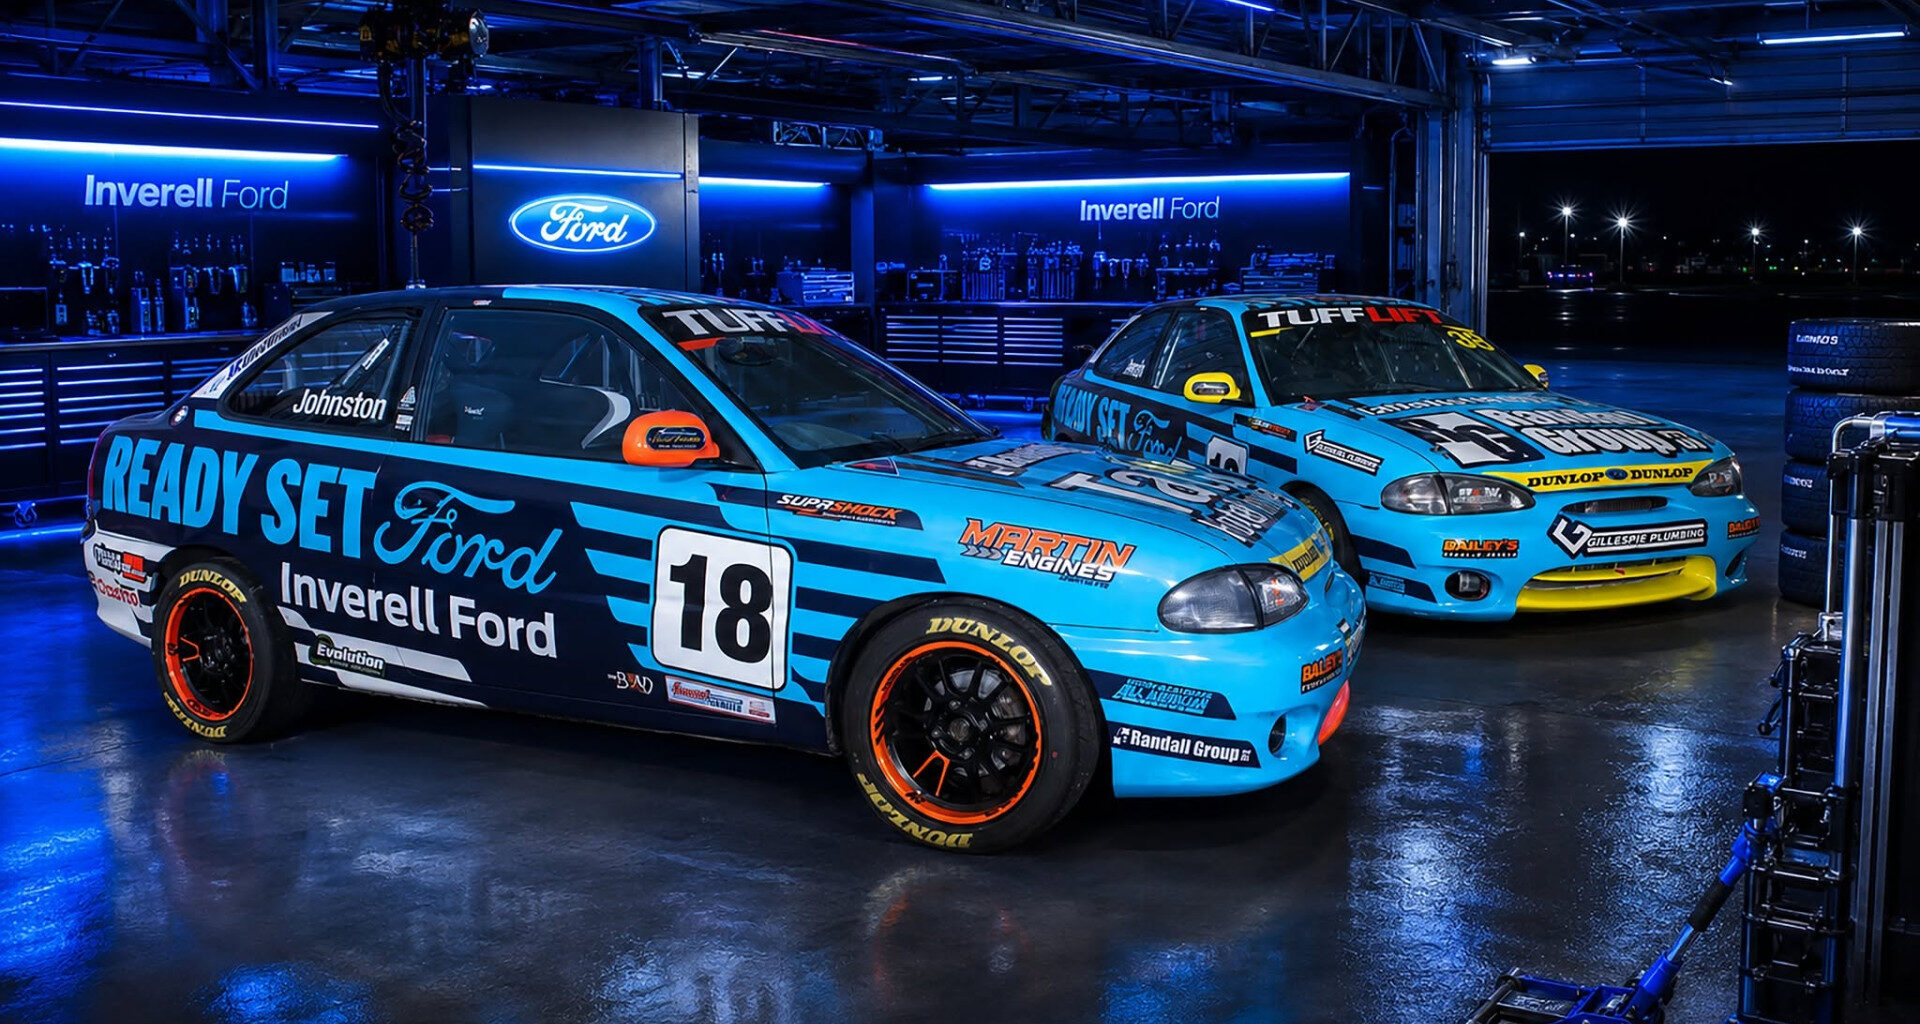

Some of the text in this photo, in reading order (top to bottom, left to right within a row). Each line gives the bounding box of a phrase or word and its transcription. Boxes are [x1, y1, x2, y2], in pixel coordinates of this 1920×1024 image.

[85, 173, 289, 210] Inverell Ford
[1079, 195, 1221, 222] Inverell Ford
[540, 201, 628, 245] Ford
[1257, 305, 1443, 329] TUFFLIFT
[292, 388, 387, 421] Johnston
[1519, 425, 1679, 457] Group
[1527, 470, 1605, 488] DUNLOP
[1629, 467, 1694, 481] DUNLOP
[103, 435, 564, 595] READY SET Ford
[777, 493, 903, 521] SUPASHOCK
[958, 519, 1137, 571] MARTIN
[1002, 549, 1117, 583] ENGINES
[178, 569, 248, 604] DUNLOP
[281, 561, 558, 660] Inverell Ford
[669, 554, 774, 664] 18
[316, 643, 385, 670] Evolution
[925, 616, 1053, 687] DUNLOP
[1130, 729, 1191, 755] Randall
[1193, 740, 1240, 764] Group
[856, 772, 974, 849] DUNLOP
